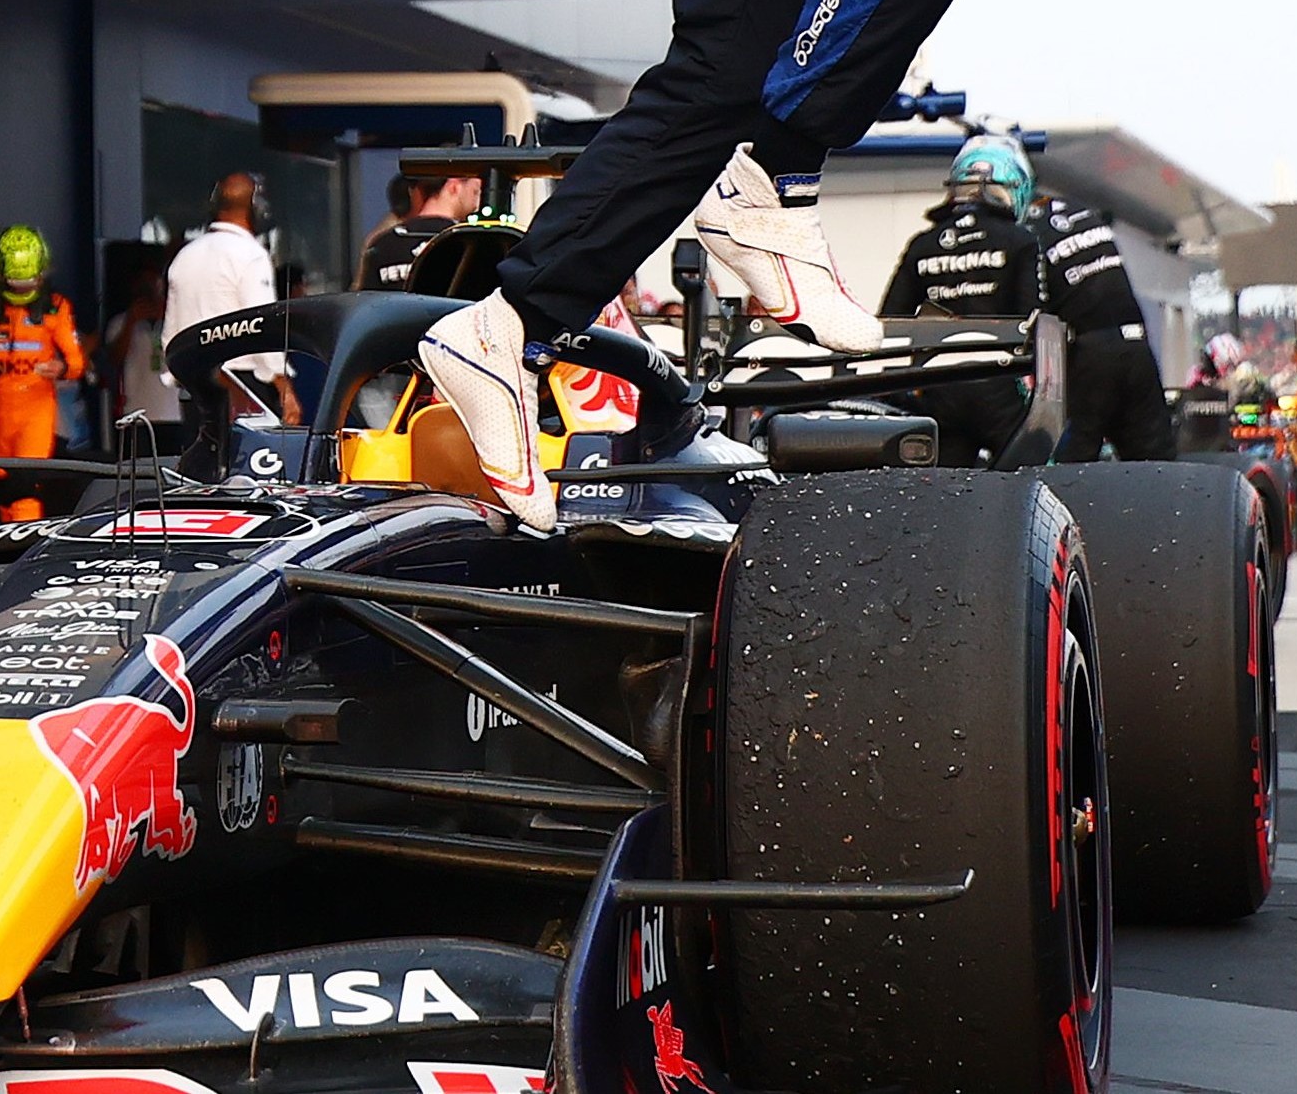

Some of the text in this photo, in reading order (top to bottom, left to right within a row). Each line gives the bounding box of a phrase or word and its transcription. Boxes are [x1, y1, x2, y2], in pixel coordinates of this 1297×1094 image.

[563, 481, 625, 502] Gate
[70, 559, 160, 569] VISA
[189, 968, 481, 1033] VISA
